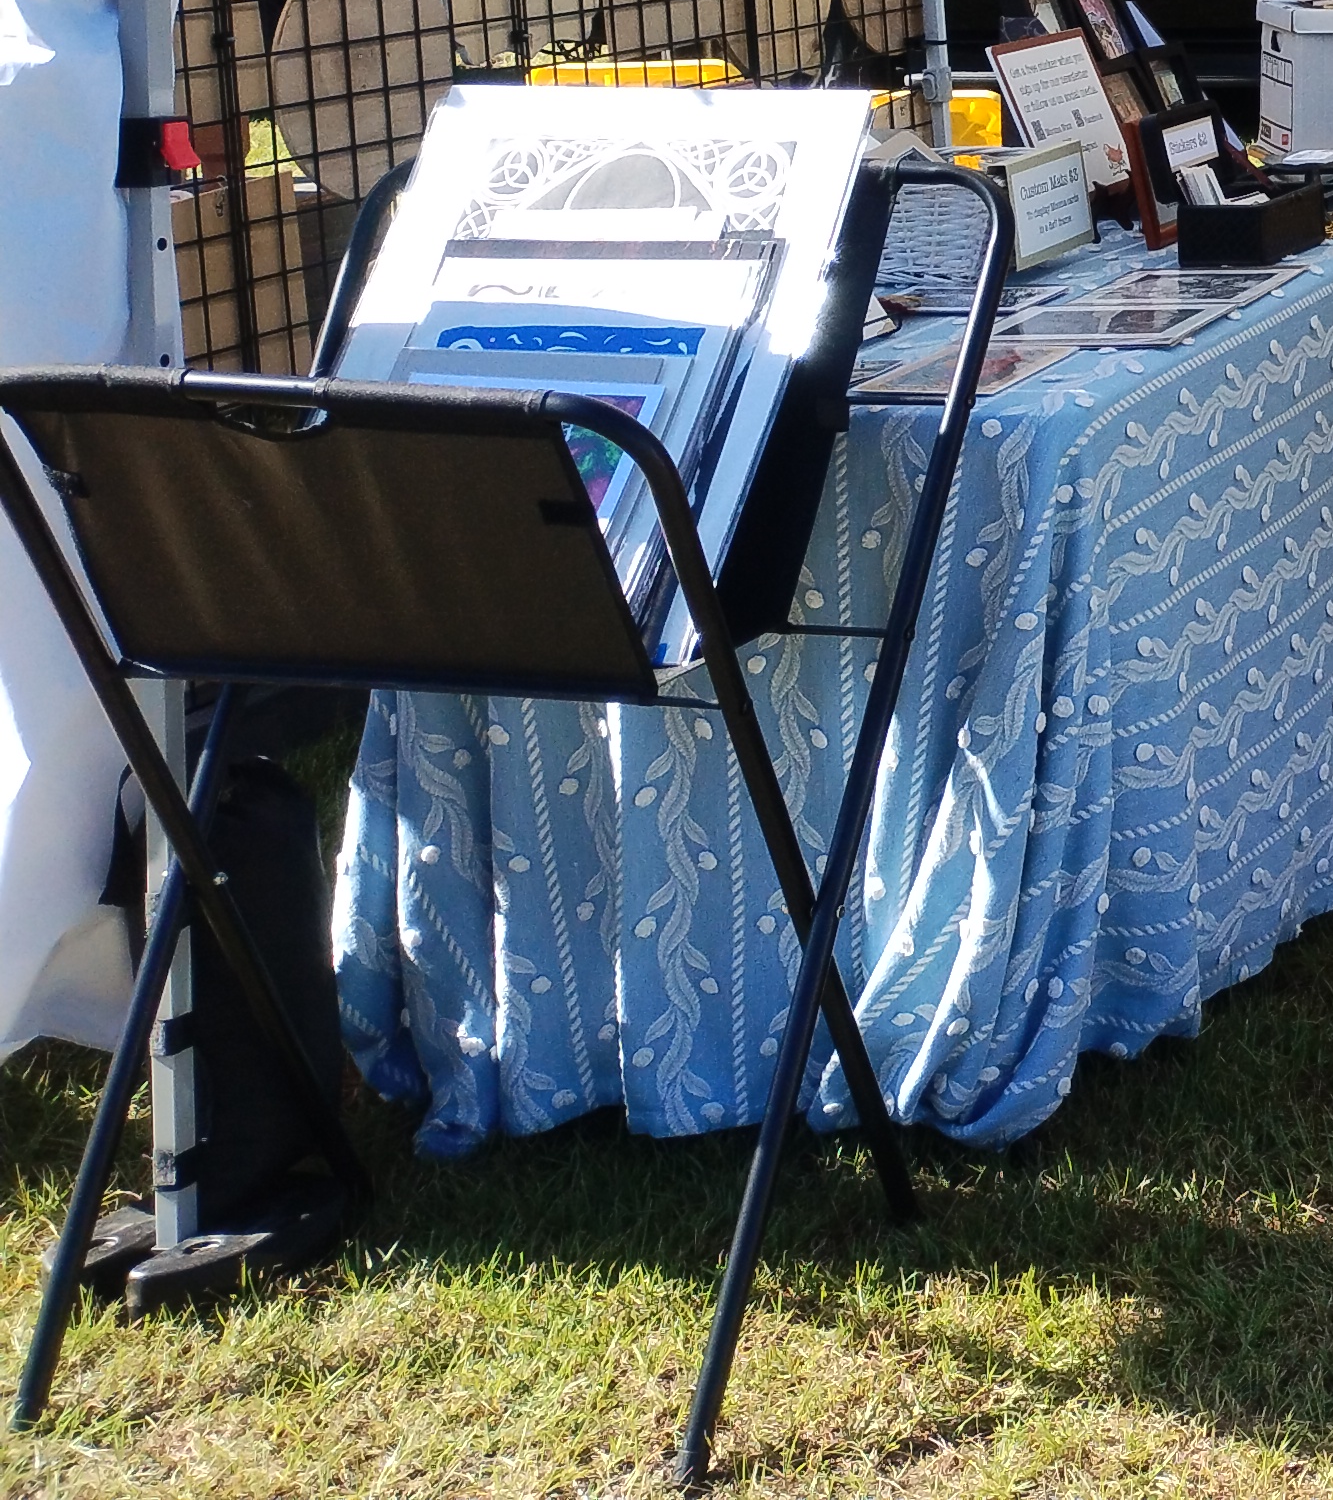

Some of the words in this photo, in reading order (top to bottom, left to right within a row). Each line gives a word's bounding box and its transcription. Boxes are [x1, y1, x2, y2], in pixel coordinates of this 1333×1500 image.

[1020, 181, 1049, 201] Custom
[1049, 174, 1069, 190] Mats
[1069, 167, 1079, 183] $3
